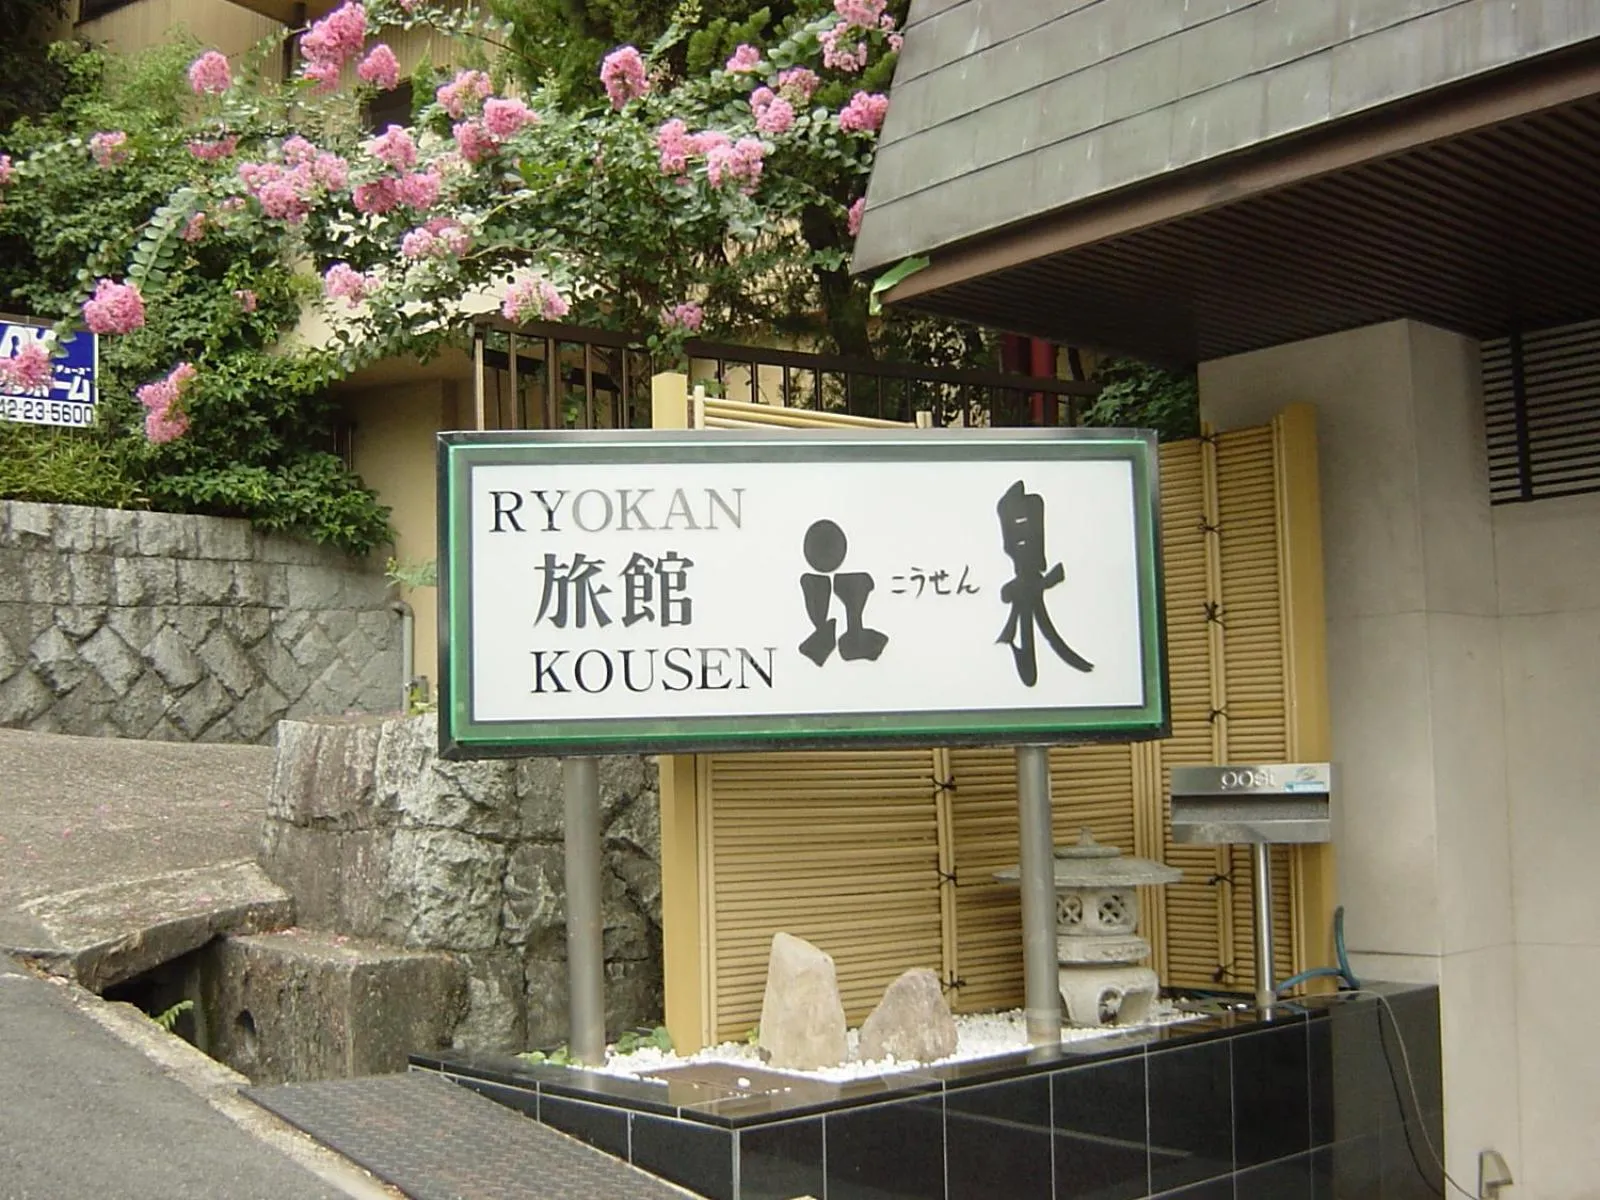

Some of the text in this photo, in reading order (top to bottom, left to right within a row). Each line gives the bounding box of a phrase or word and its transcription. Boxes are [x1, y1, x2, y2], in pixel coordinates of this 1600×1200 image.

[488, 487, 746, 534] RYOKAN
[534, 551, 694, 629] 旅館
[891, 565, 980, 597] こうせん
[530, 647, 776, 694] KOUSEN
